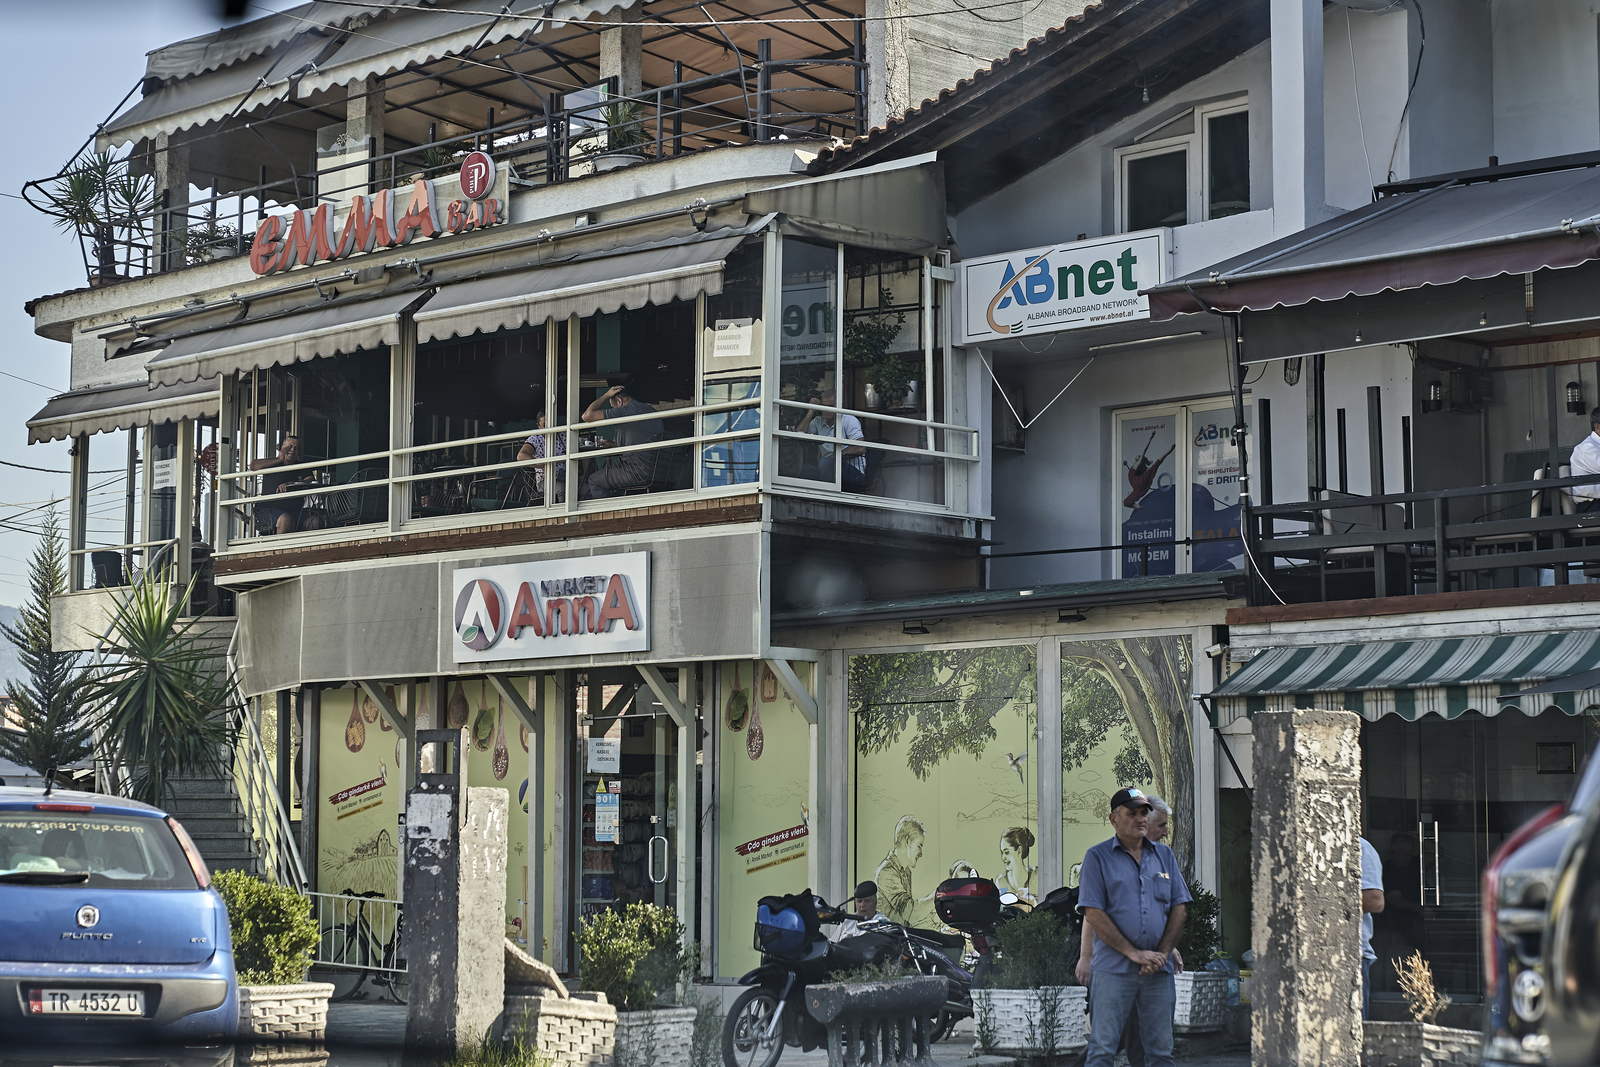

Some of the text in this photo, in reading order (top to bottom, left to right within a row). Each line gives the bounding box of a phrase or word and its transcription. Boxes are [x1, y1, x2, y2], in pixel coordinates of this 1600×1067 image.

[447, 199, 500, 233] BAR
[250, 180, 440, 275] EMMA
[997, 247, 1138, 310] ABnet
[1027, 298, 1138, 321] ALBANIA BROADBAND NETWORK
[1089, 310, 1134, 322] www.abnet.al
[1127, 527, 1173, 541] Instalimi
[540, 575, 608, 597] MARKET
[507, 574, 638, 639] AnnA
[61, 931, 114, 941] PUNTO
[48, 992, 138, 1012] TR 4532 U
